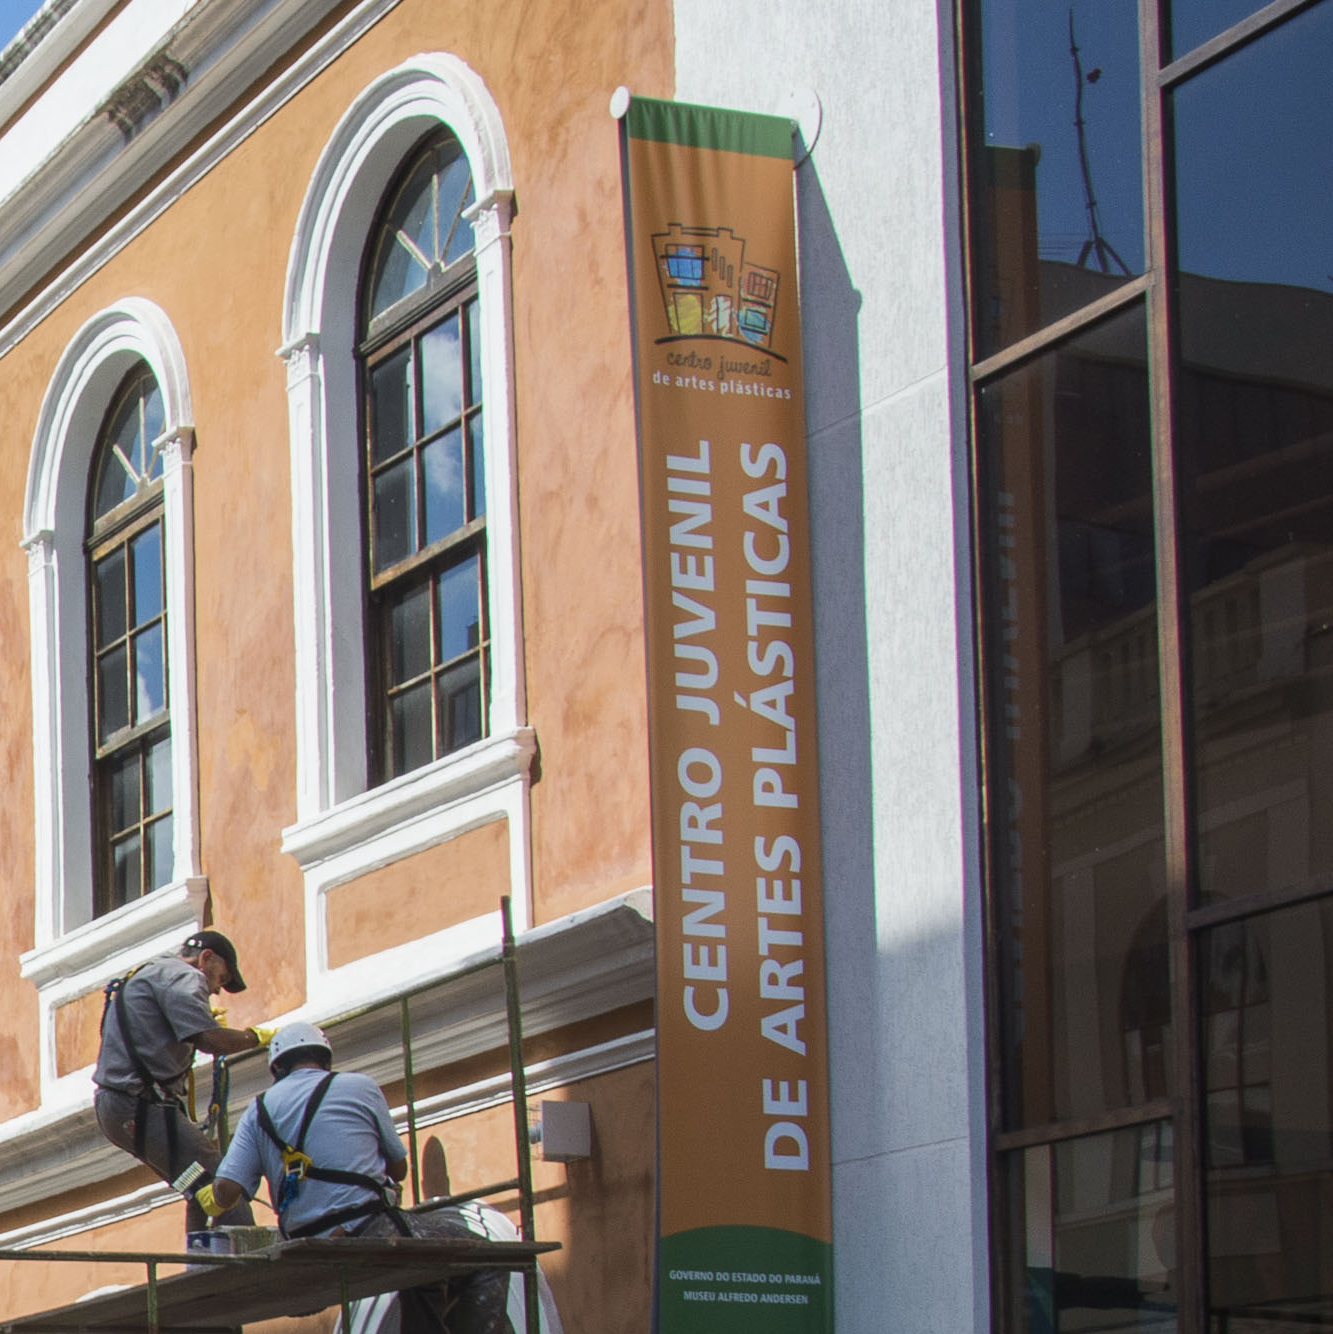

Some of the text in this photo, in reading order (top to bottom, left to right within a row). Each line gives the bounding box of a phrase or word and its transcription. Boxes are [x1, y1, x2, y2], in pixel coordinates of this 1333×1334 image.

[667, 351, 772, 380] centro juvenil
[652, 370, 792, 400] de artes plásticas
[666, 439, 729, 1032] CENTRO JUVENIL
[734, 442, 810, 1172] DE ARTES PLÁSTICAS
[669, 1270, 822, 1285] GOVERNO DO ESTADO DO PARANÁ
[683, 1291, 809, 1305] MUSEU ALFREDO ANDERSEN
